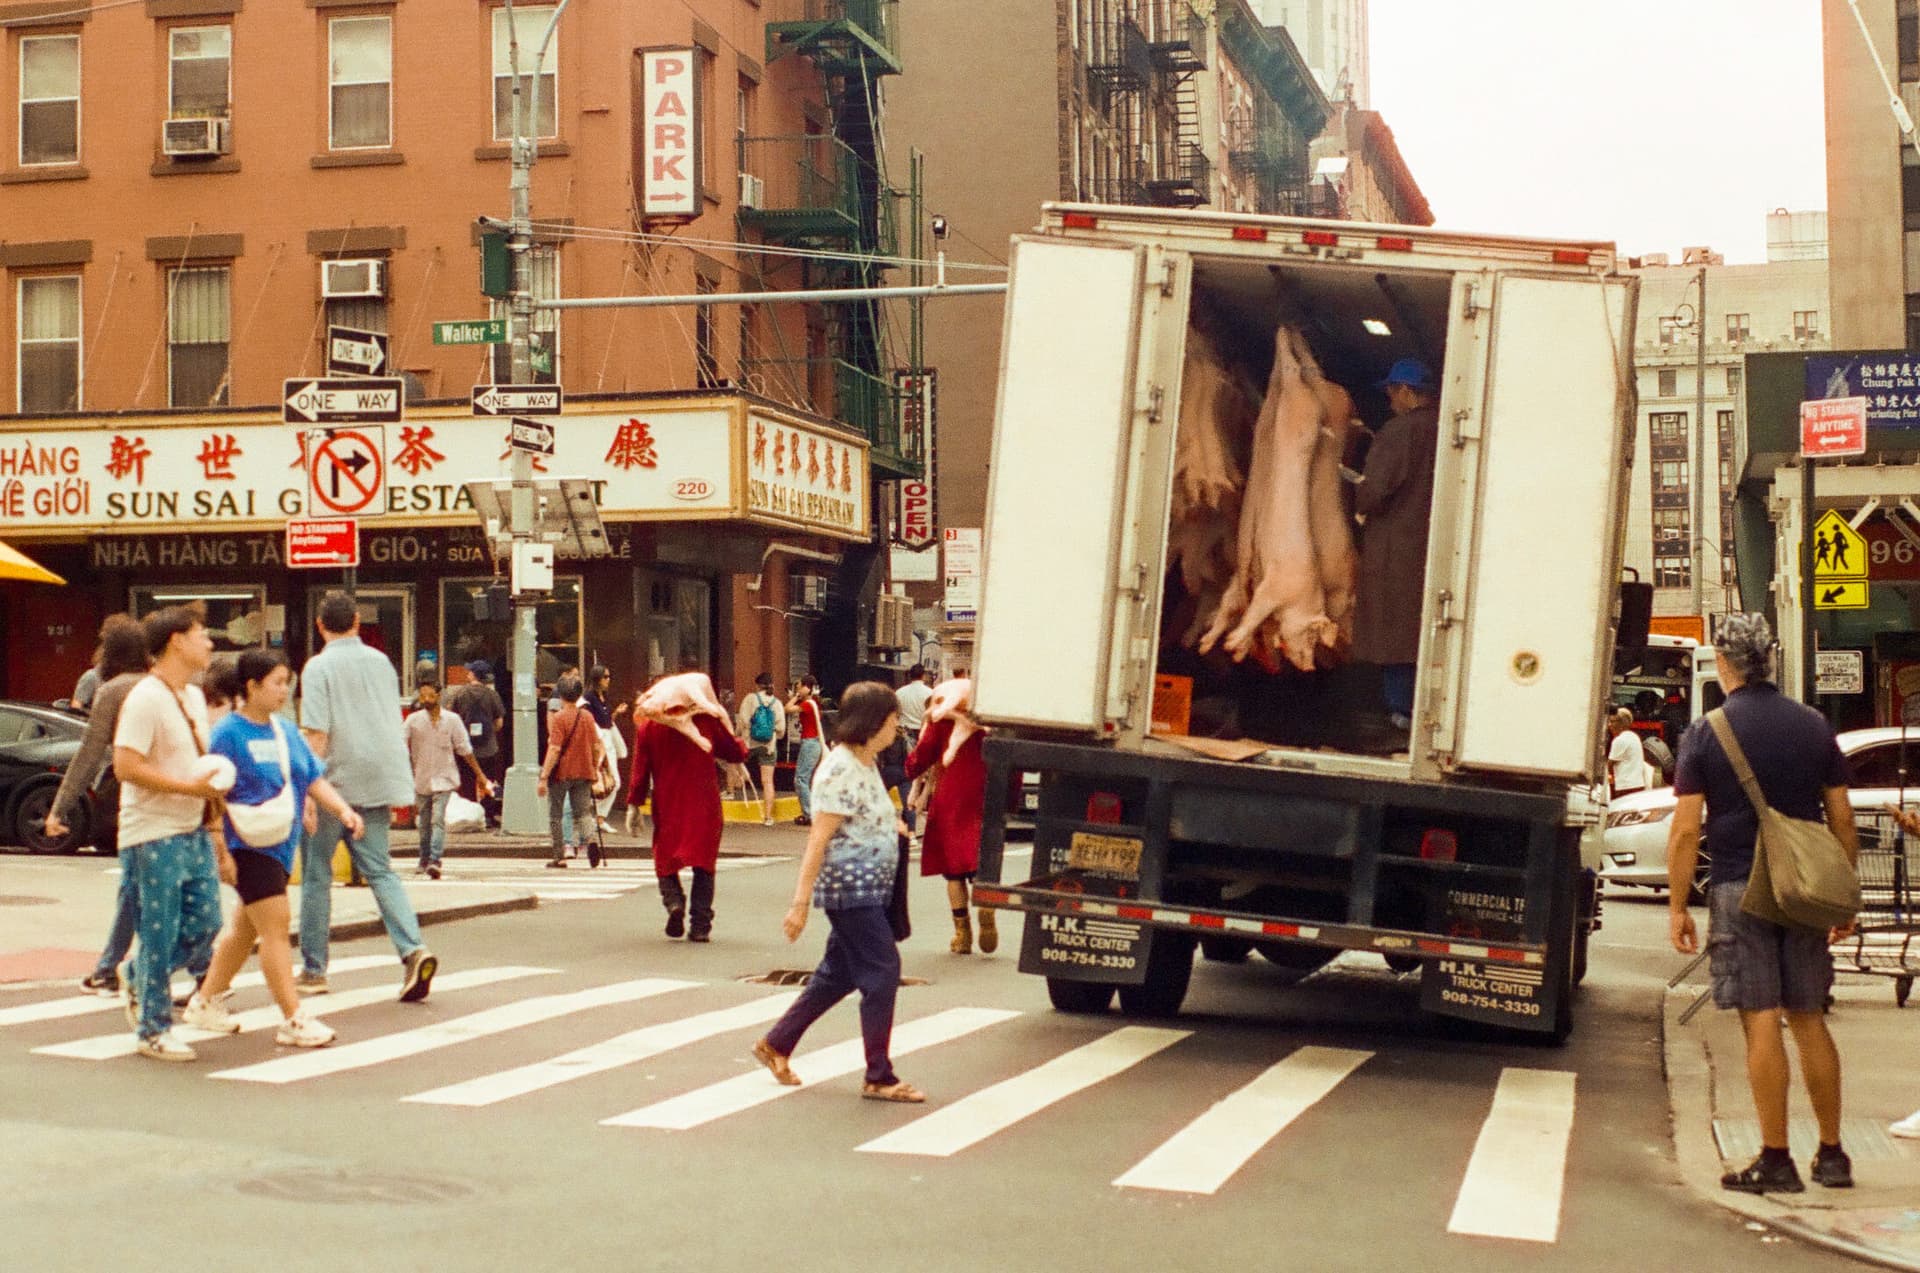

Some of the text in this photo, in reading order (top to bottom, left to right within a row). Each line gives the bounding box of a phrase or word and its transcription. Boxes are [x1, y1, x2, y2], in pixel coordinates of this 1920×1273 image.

[654, 58, 687, 181] PARK
[441, 324, 486, 343] Walker
[338, 341, 354, 360] ONE
[1862, 377, 1915, 389] Chung Pak
[297, 393, 392, 410] ONE WAY
[482, 394, 554, 407] ONE WAY
[1805, 405, 1818, 418] NO
[515, 426, 529, 440] ONE
[1812, 419, 1855, 433] ANYTIME
[0, 440, 80, 475] HÀNG
[677, 482, 708, 495] 220
[751, 479, 768, 509] SUN
[106, 491, 179, 518] SUN
[193, 490, 255, 517] SAI
[904, 483, 928, 540] OPEN
[291, 523, 348, 534] NO STANDING
[291, 536, 328, 547] Anytime
[1870, 539, 1914, 564] 96
[1448, 890, 1511, 911] COMMERCIAL
[1041, 914, 1084, 933] H.K.
[1053, 932, 1131, 952] TRUCK CENTER
[1042, 948, 1136, 969] 908-754-3330
[1439, 960, 1485, 978] H.K.
[1452, 975, 1533, 998] TRUCK CENTER
[1441, 990, 1540, 1016] 908-754-3330
